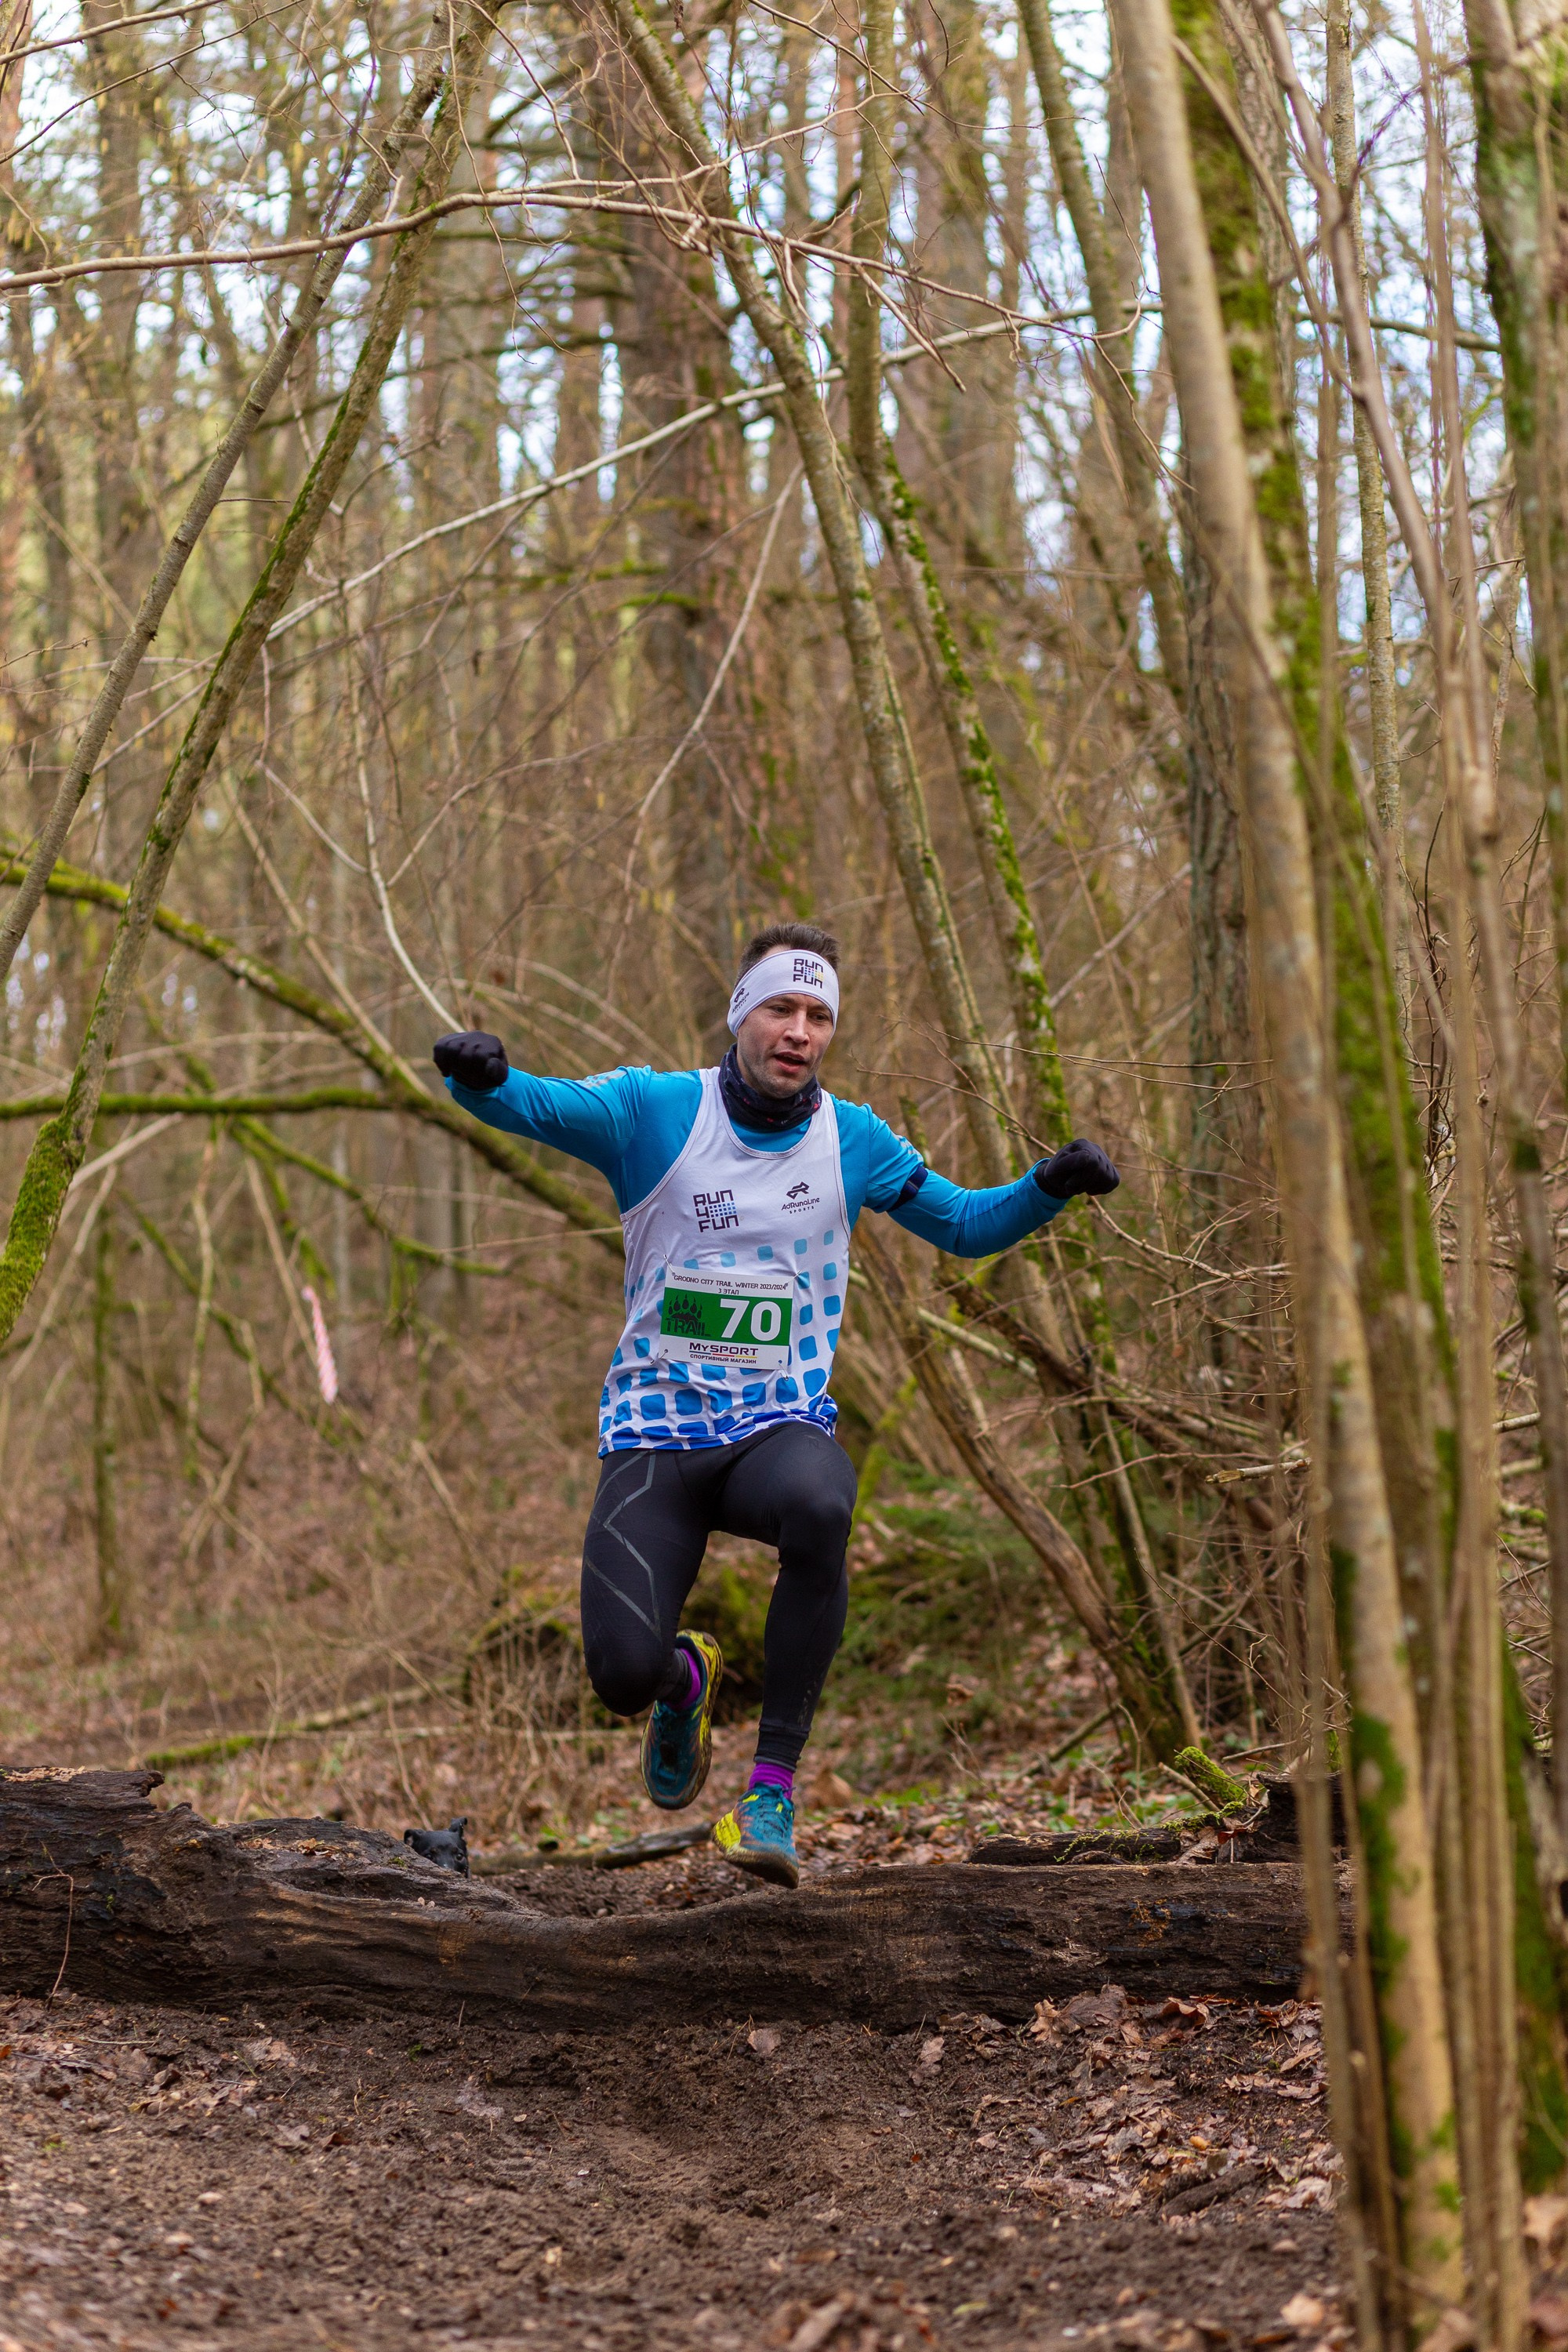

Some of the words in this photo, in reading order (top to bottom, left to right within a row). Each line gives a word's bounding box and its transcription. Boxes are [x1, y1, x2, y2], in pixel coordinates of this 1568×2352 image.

[793, 958, 824, 973] RUN
[793, 974, 823, 989] FUN
[693, 1189, 734, 1207] RUN
[695, 1206, 710, 1218] 4
[789, 1205, 815, 1214] SPORTS
[698, 1214, 739, 1233] FUN
[673, 1275, 699, 1284] GRODNO
[720, 1298, 782, 1341] 70
[665, 1317, 712, 1338] TRAIL
[690, 1353, 729, 1363] СПОРТИВНЫЙ
